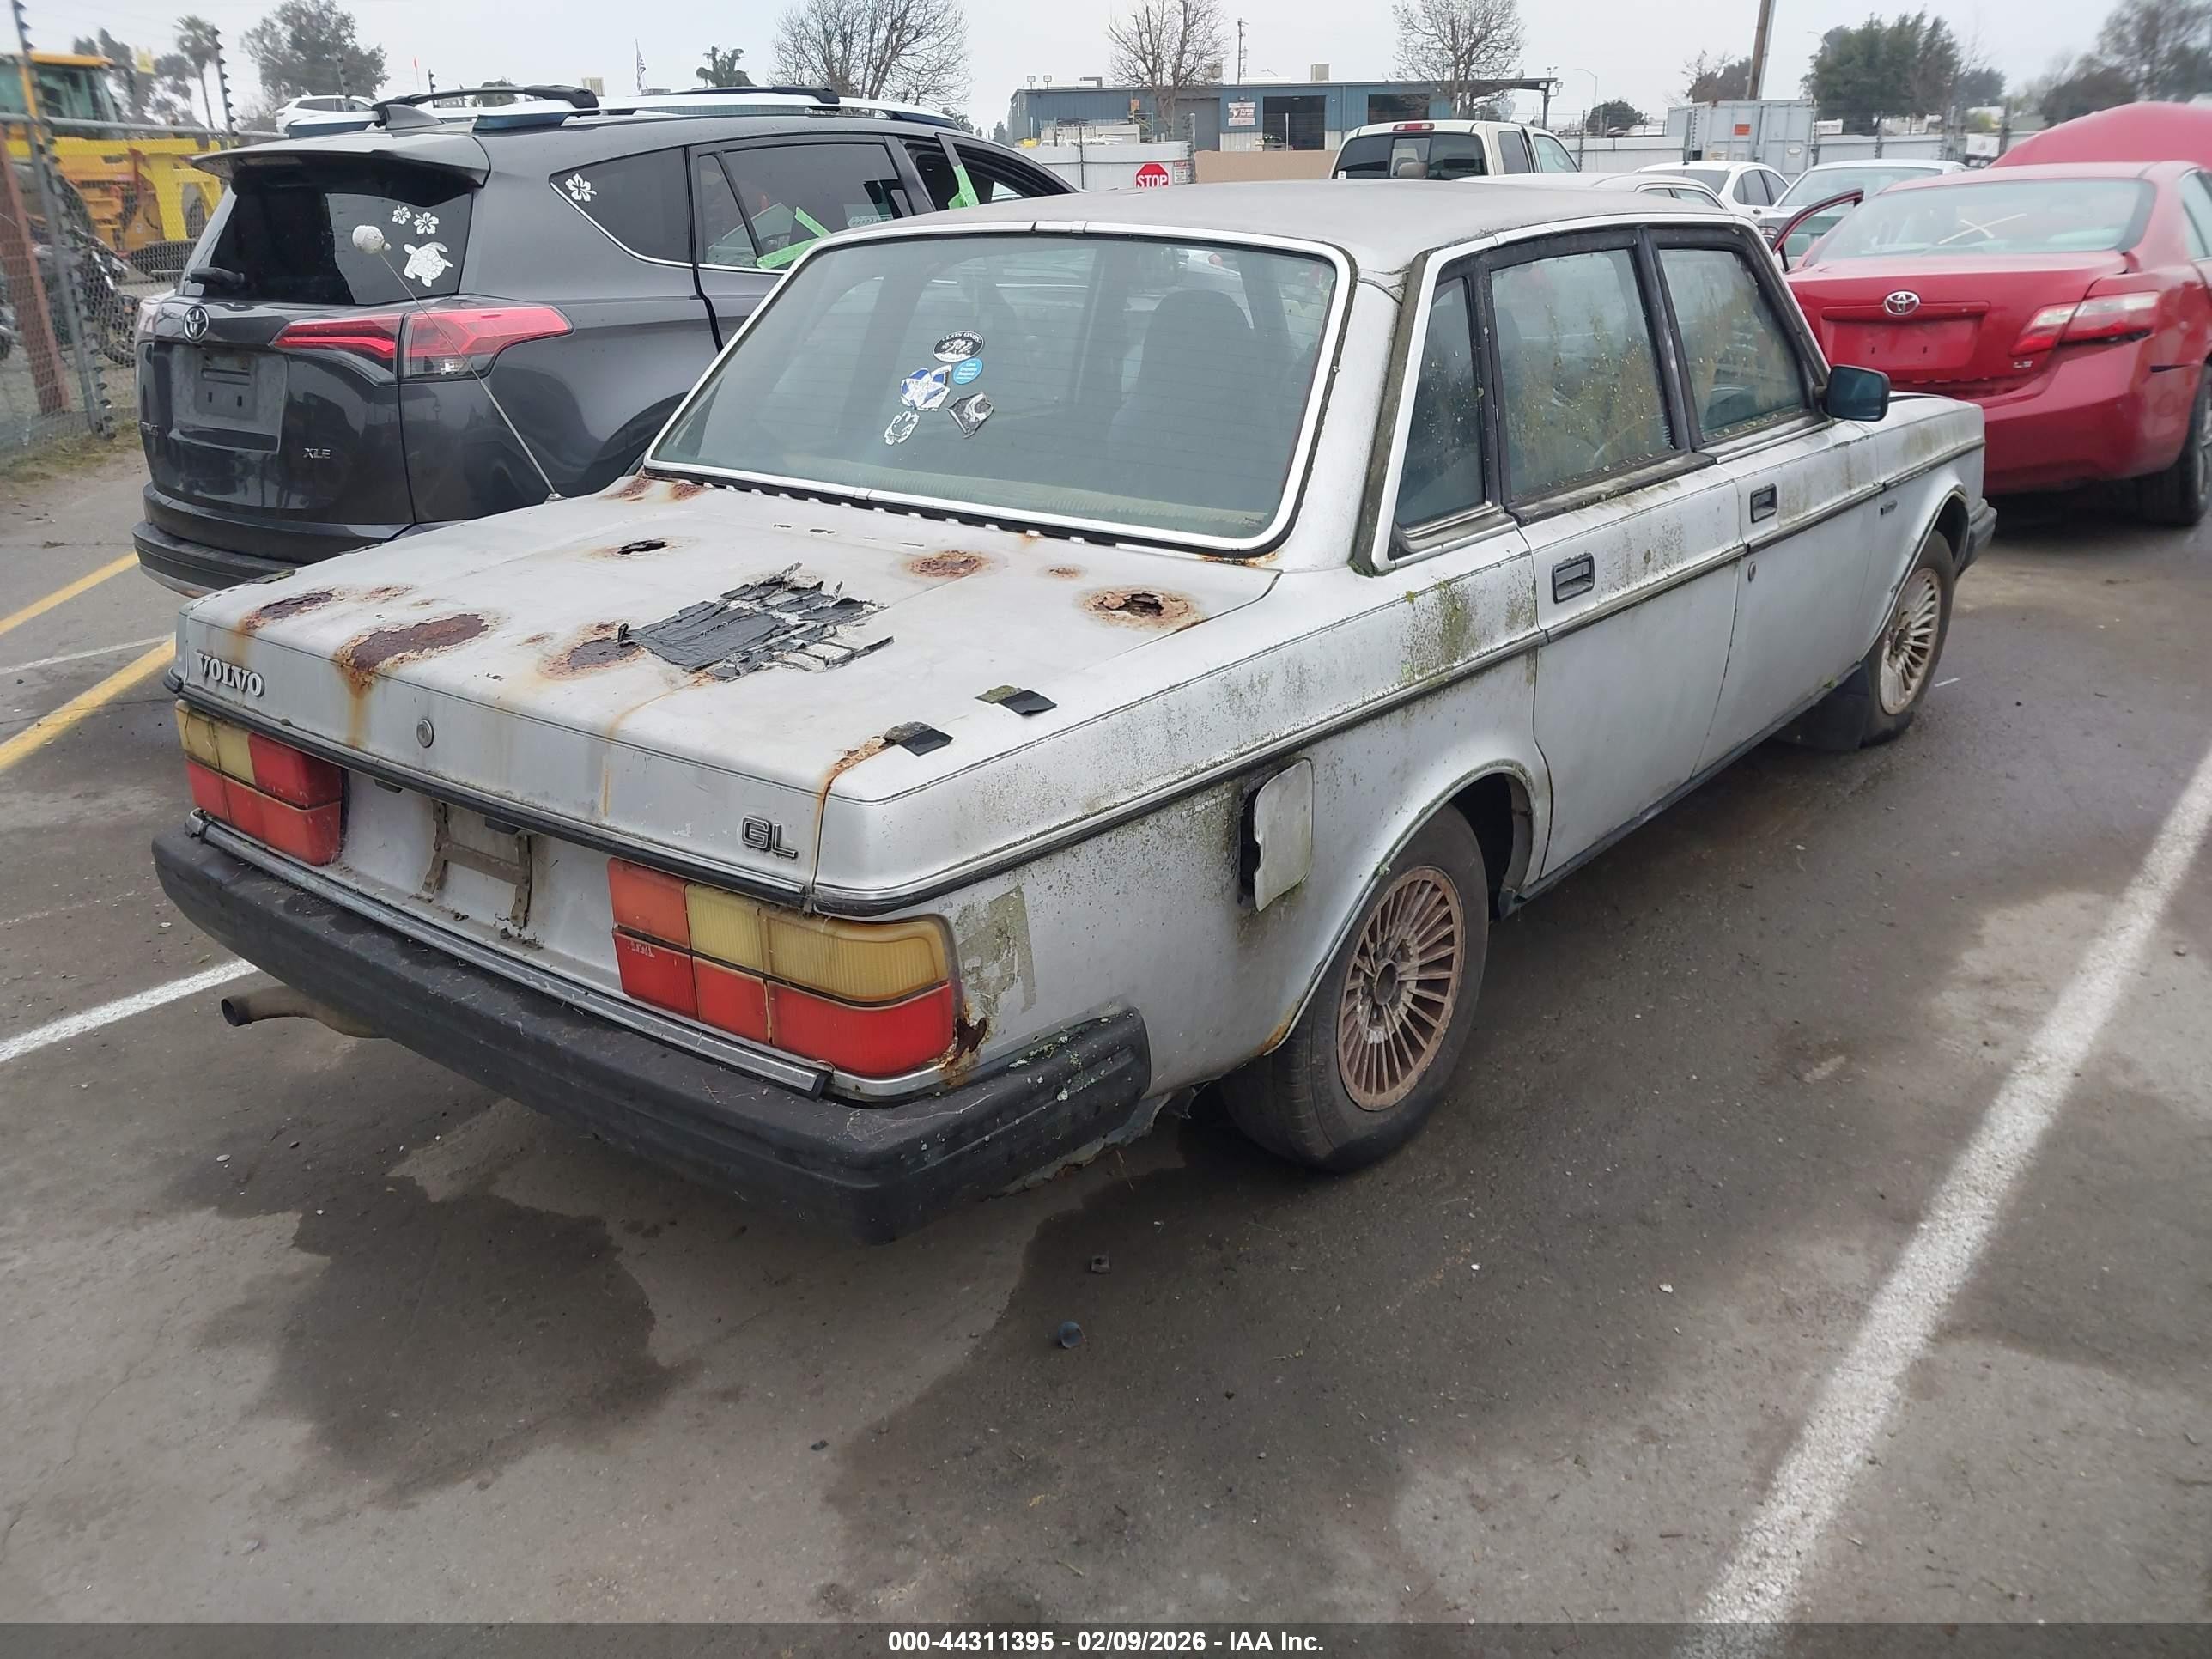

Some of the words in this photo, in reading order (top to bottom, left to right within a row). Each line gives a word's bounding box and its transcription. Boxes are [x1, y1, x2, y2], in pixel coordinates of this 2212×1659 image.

[1137, 174, 1168, 188] STOP
[302, 447, 331, 459] XLE
[194, 650, 265, 697] VOLVO
[742, 816, 799, 859] GL
